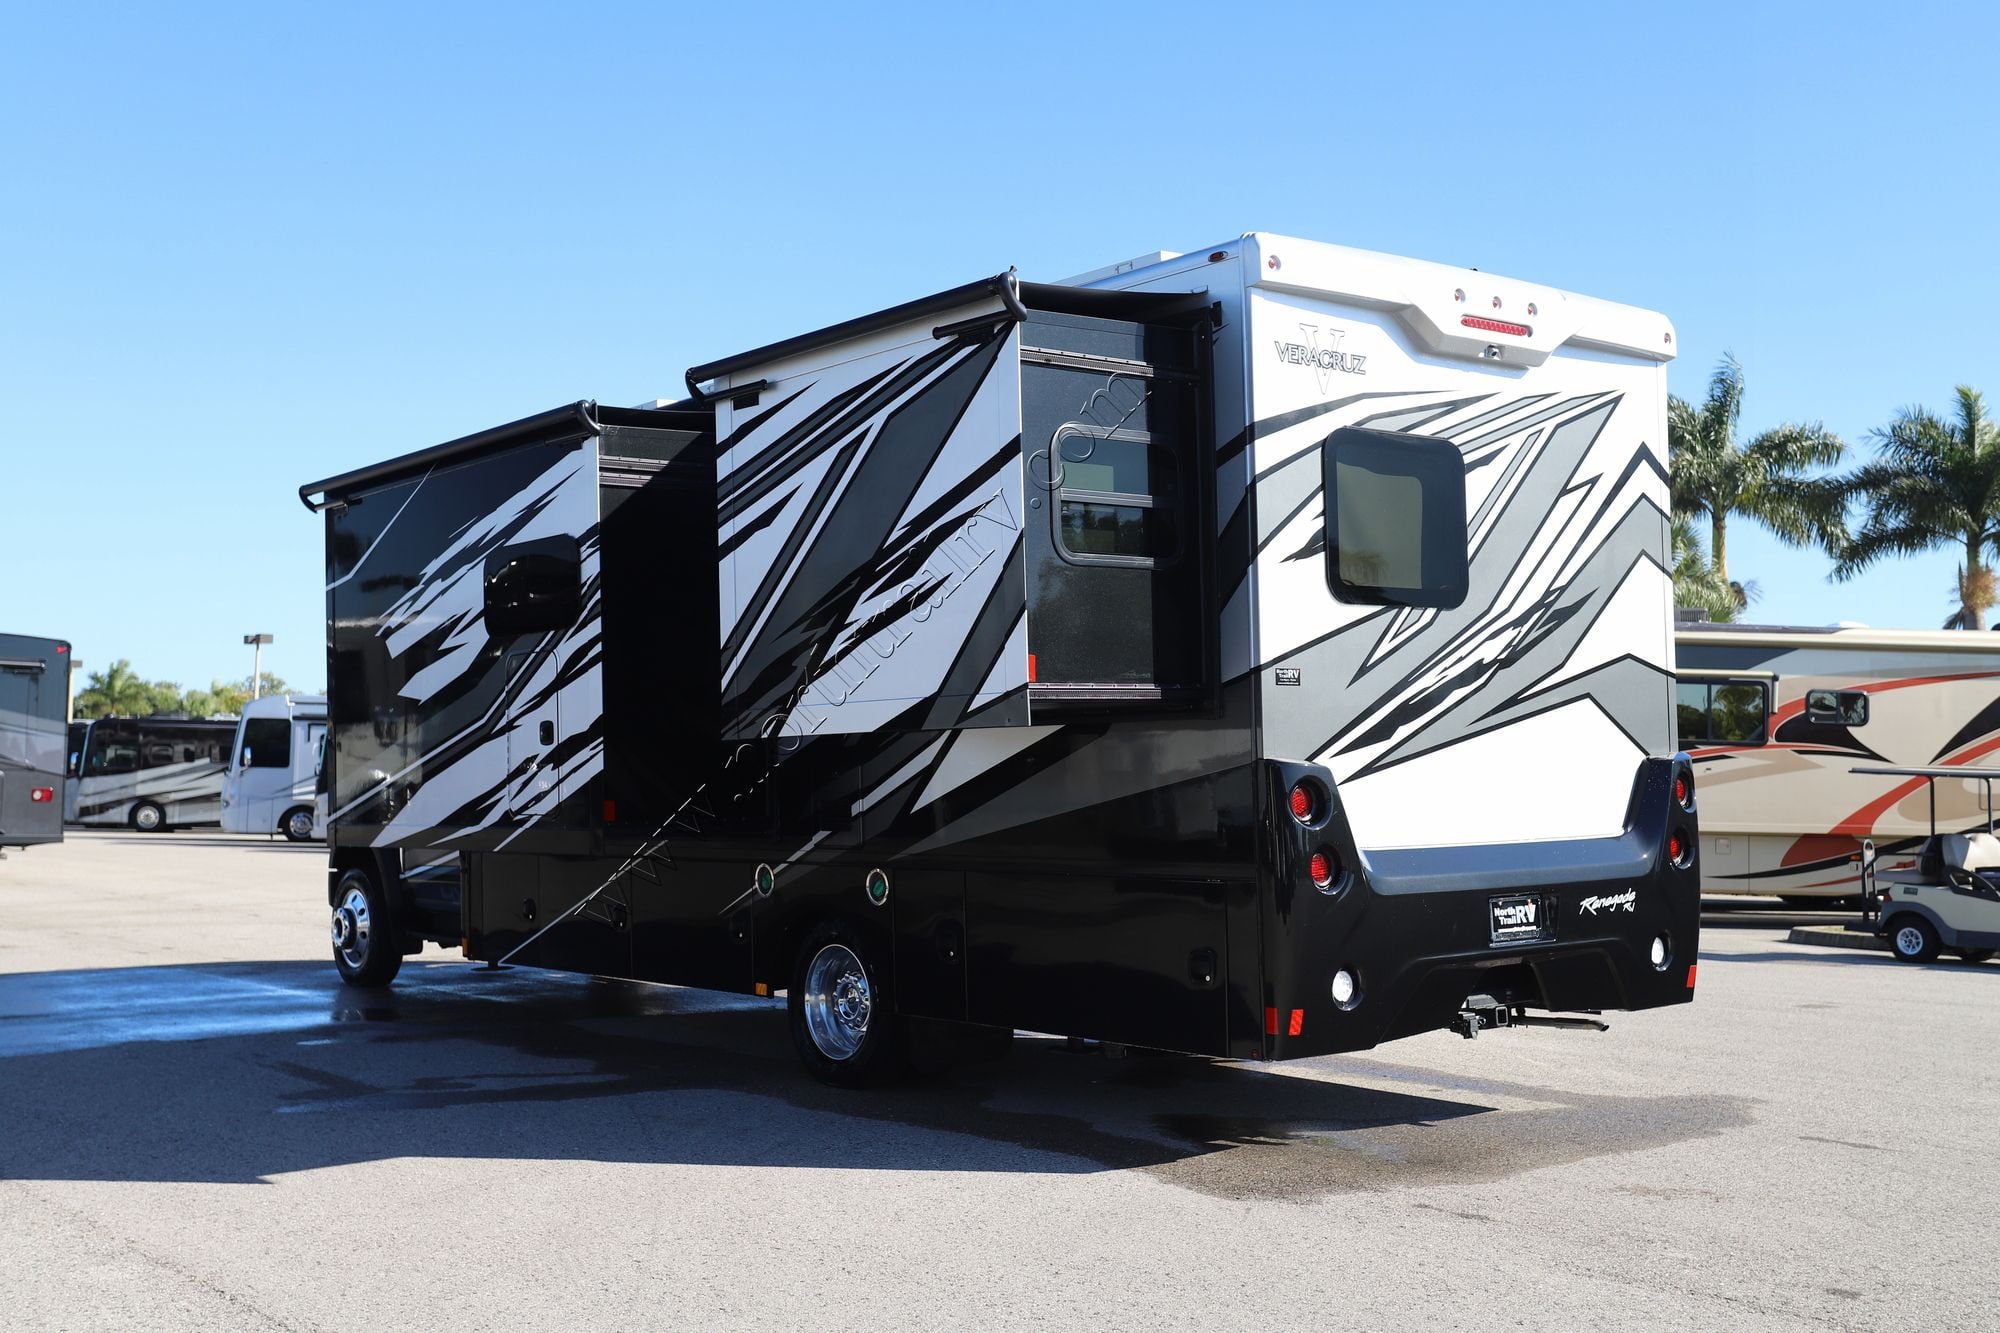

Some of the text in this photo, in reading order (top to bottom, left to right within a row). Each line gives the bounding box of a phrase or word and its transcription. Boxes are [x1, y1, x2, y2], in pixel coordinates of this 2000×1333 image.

[1274, 341, 1367, 375] VERACRUZ
[1579, 887, 1636, 915] Renegade
[1622, 901, 1636, 913] RV
[1494, 906, 1516, 917] North
[1515, 904, 1536, 924] RV
[1498, 915, 1517, 926] Trail
